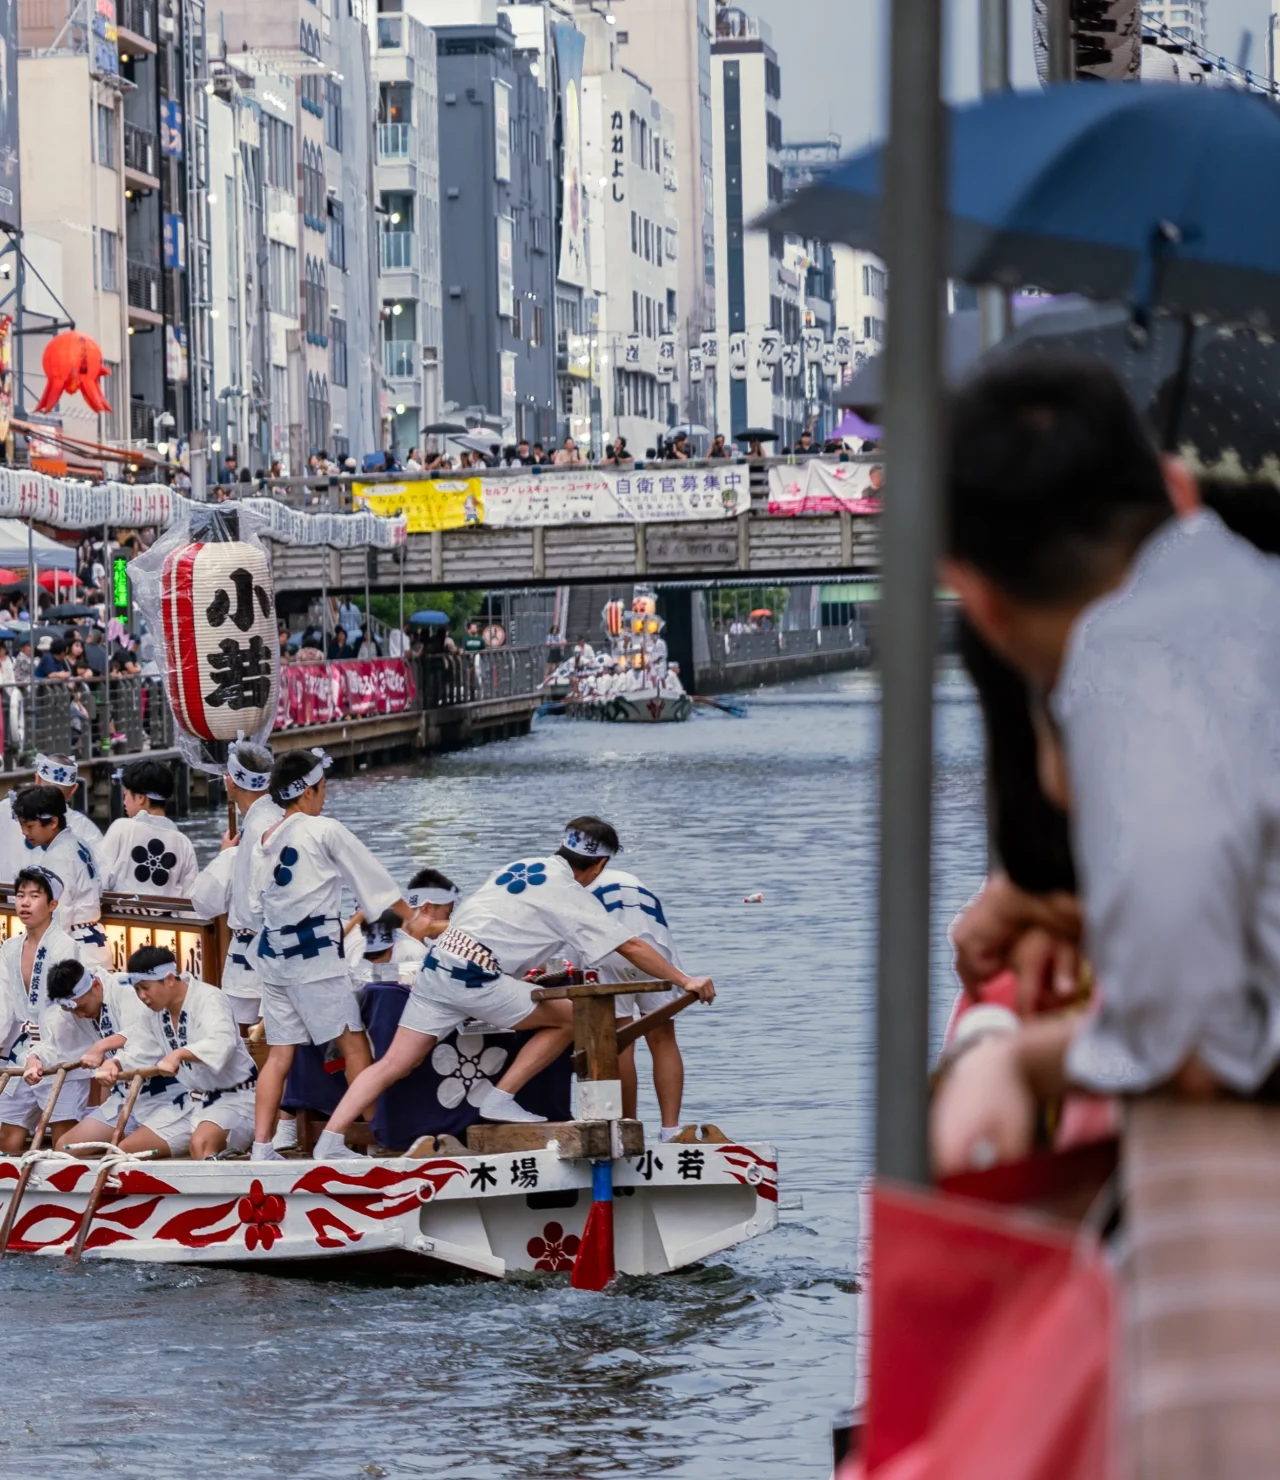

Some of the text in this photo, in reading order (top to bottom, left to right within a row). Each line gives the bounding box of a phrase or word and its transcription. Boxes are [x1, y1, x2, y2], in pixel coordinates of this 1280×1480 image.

[616, 471, 742, 495] 自衛官募集中
[205, 567, 272, 712] 小若
[40, 764, 49, 776] 木
[234, 770, 246, 782] 木
[469, 1156, 540, 1193] 木場
[635, 1148, 706, 1181] 小若
